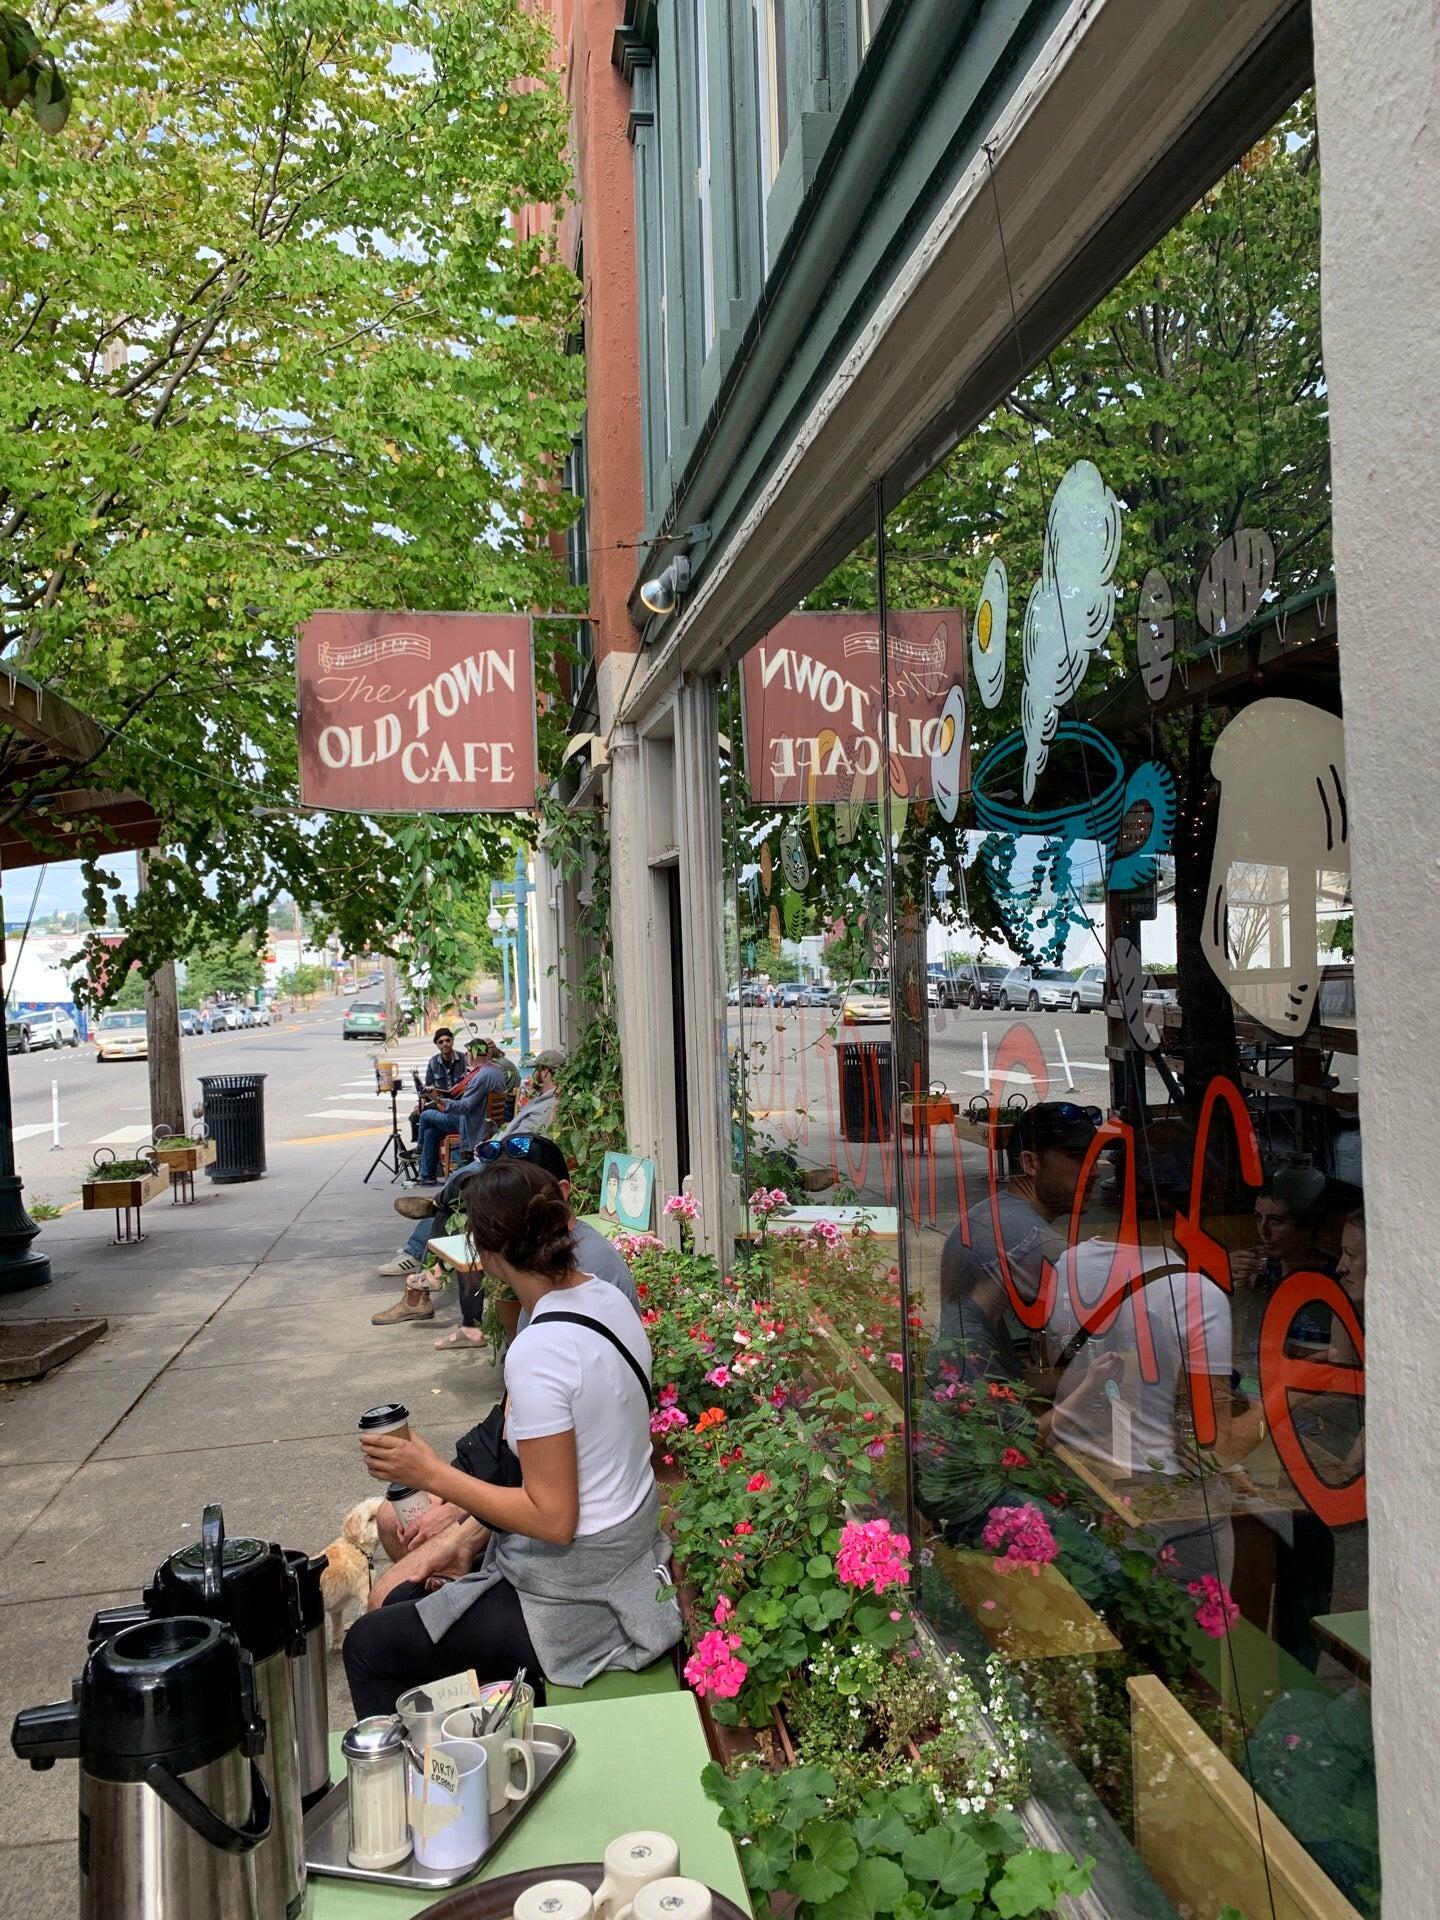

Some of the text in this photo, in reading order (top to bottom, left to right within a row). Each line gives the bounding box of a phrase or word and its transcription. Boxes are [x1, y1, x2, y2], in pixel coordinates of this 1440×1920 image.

[317, 674, 407, 704] The
[318, 649, 516, 768] OLD TOWN
[401, 741, 515, 785] CAFE
[432, 1759, 455, 1780] DIRTY
